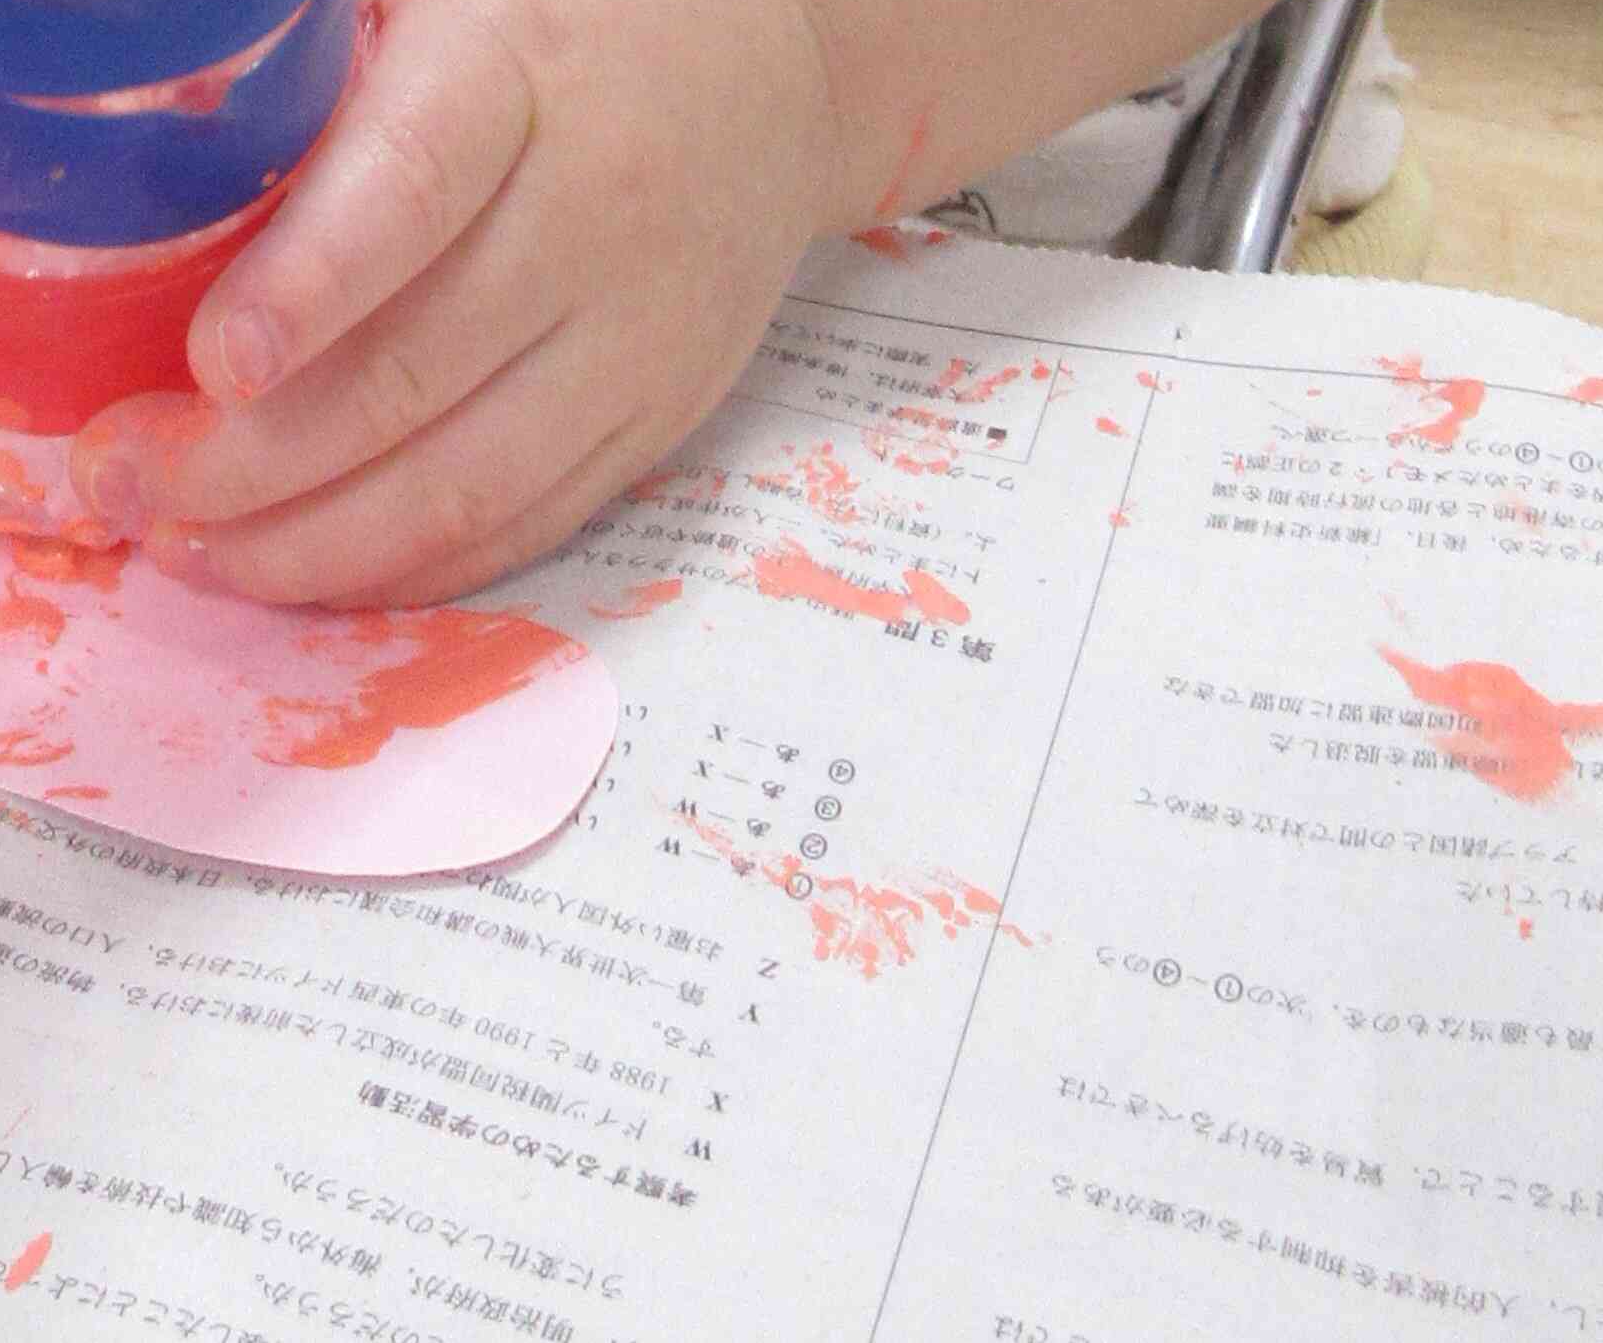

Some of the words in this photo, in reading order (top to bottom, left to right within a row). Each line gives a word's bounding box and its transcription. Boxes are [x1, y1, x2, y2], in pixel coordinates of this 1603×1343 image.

[756, 954, 781, 979] Z
[737, 999, 762, 1026] Y
[704, 1088, 728, 1114] X
[356, 1079, 698, 1208] 考察するための学習活動
[682, 1135, 713, 1161] W
